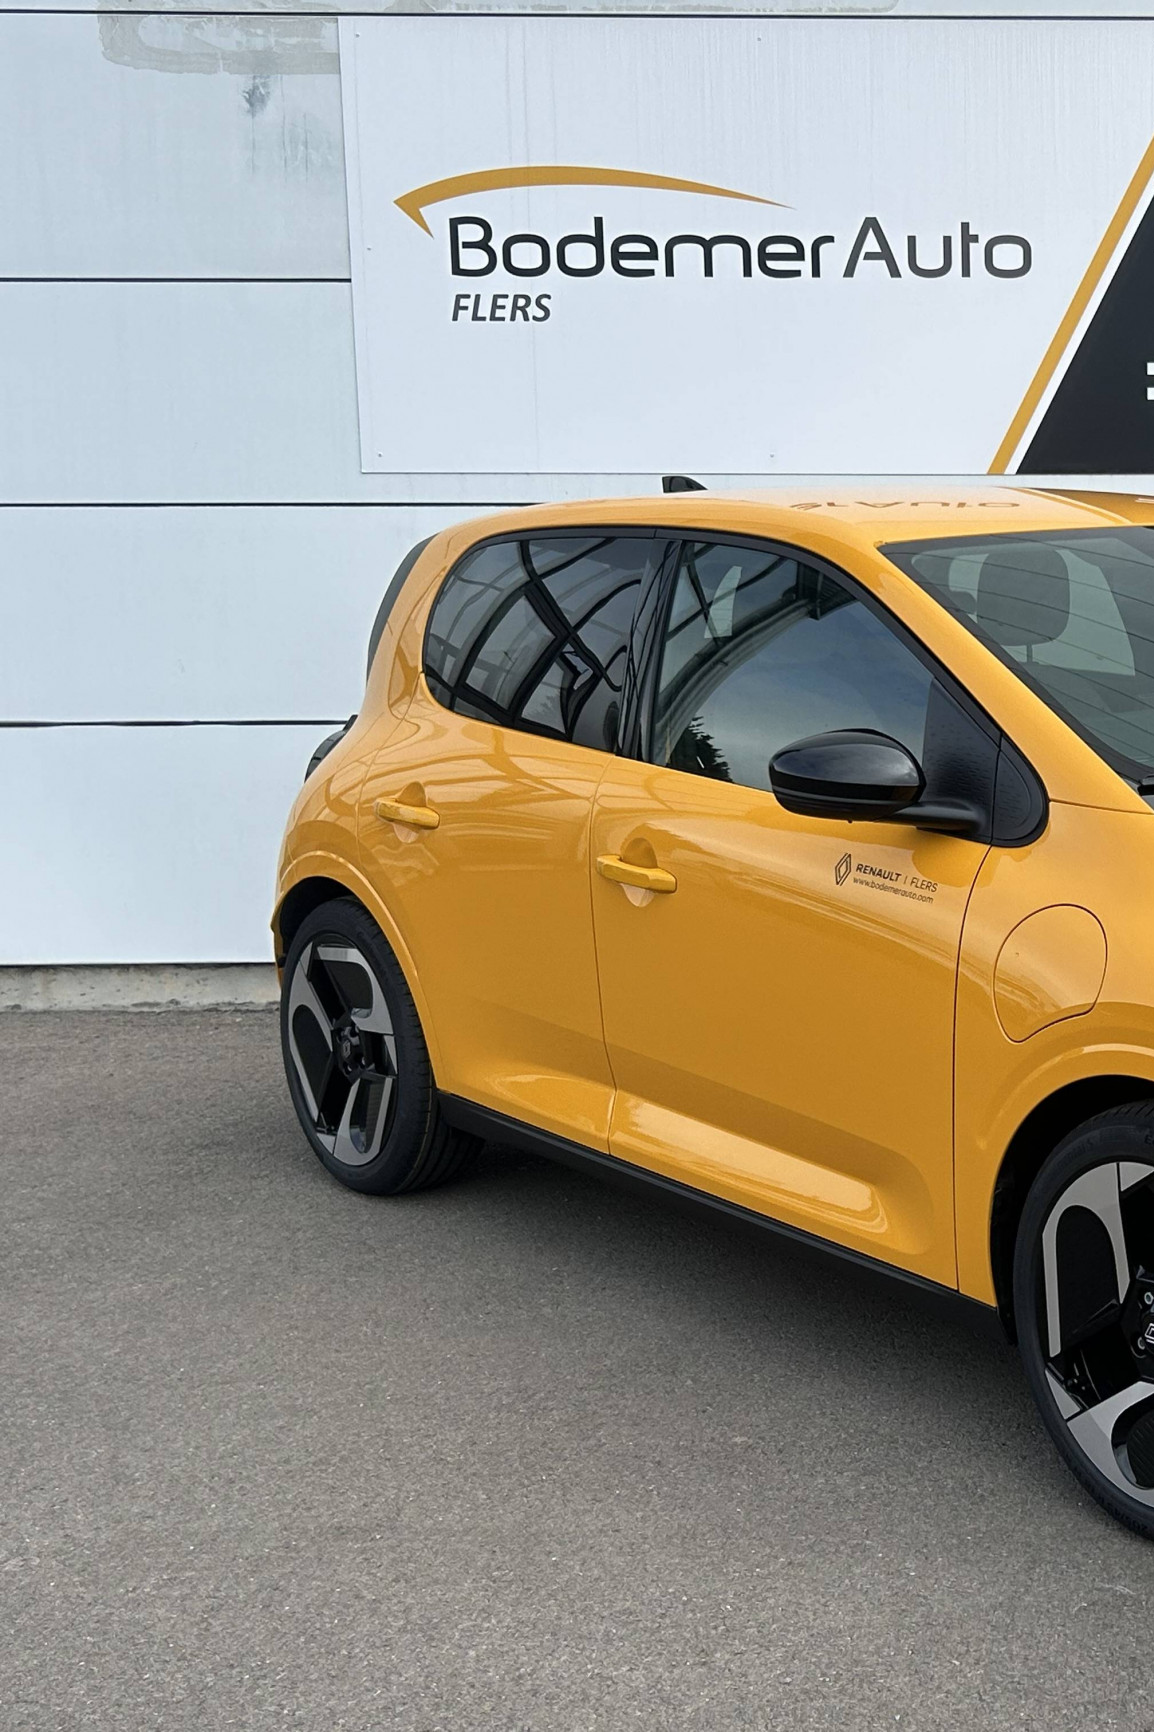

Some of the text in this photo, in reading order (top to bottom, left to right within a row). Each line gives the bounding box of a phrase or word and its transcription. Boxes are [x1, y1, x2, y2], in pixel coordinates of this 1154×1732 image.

[451, 293, 551, 322] FLERS
[853, 877, 934, 904] www.bodemerauto.com
[856, 863, 938, 893] RENAULT FLERS
